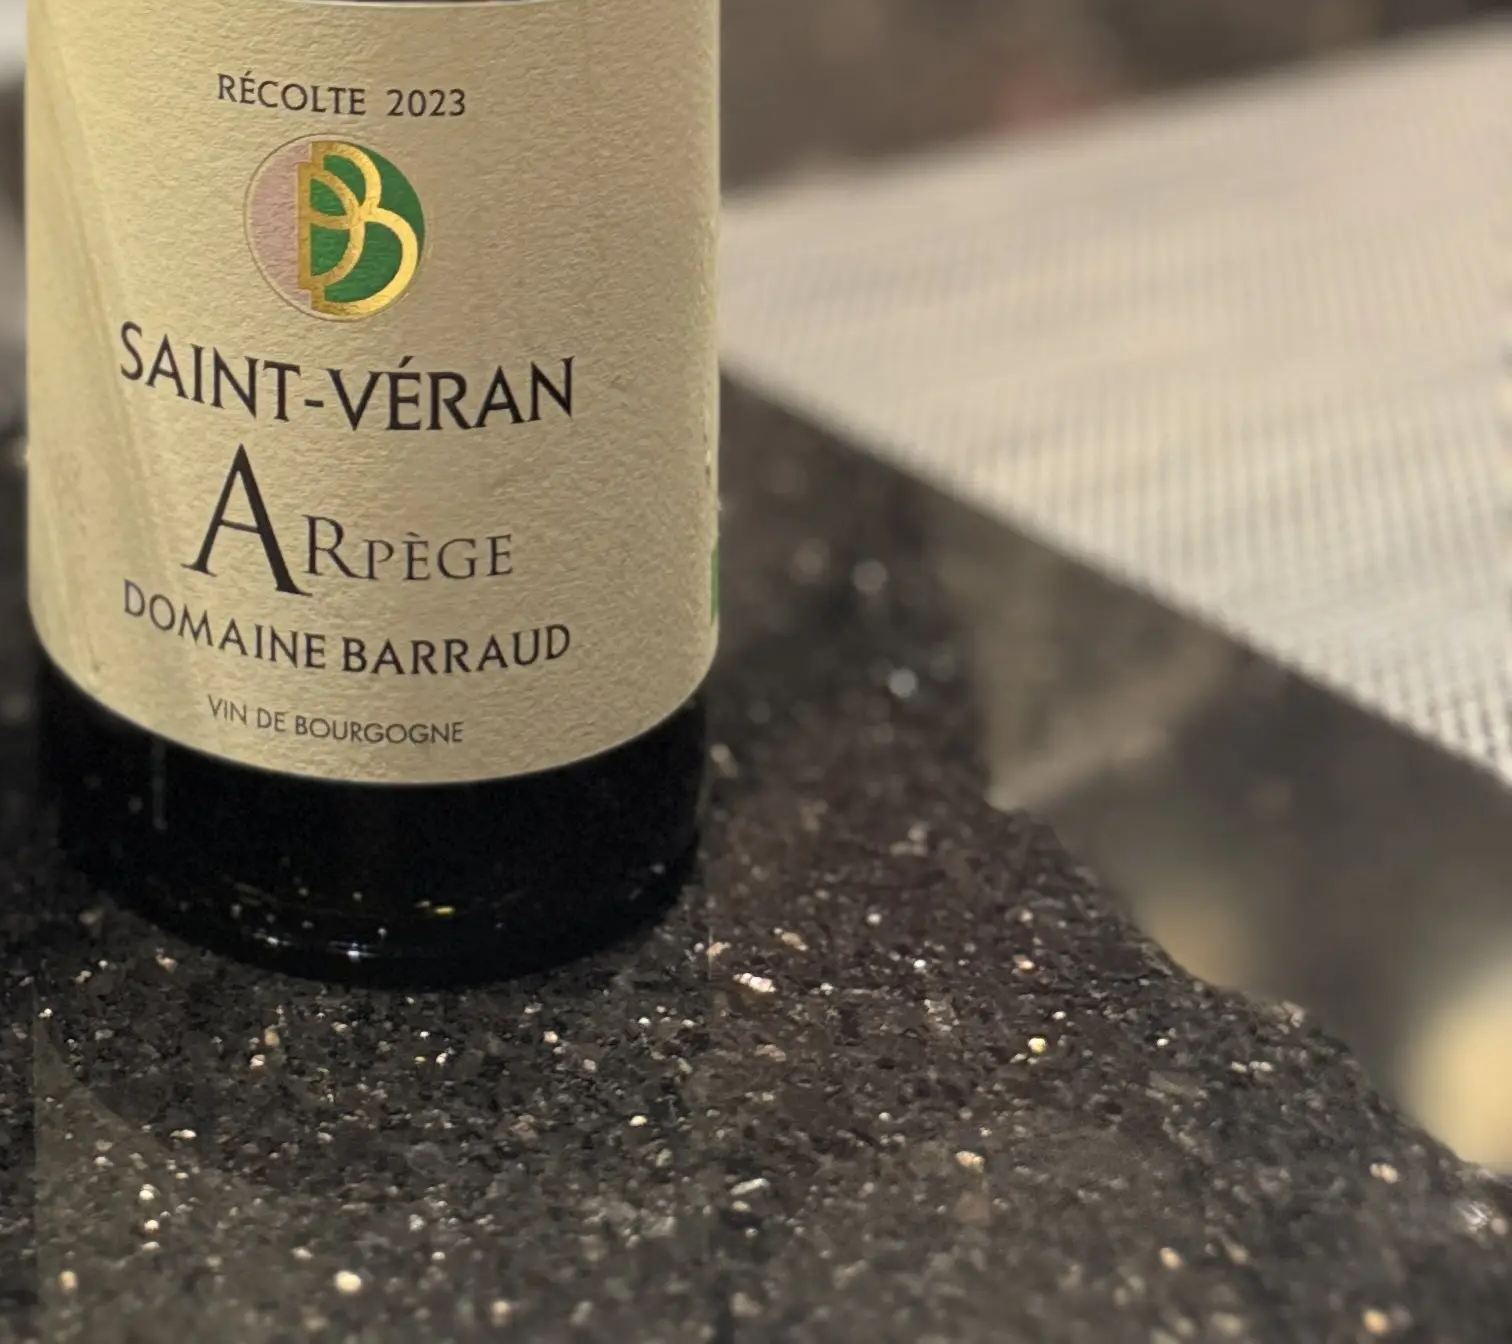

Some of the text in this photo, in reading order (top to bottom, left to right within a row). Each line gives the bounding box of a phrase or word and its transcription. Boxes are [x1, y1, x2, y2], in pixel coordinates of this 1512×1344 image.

[217, 72, 466, 117] RÉCOLTE 2023
[120, 321, 574, 432] SAINT-VÉRAN
[123, 580, 570, 674] DOMAINE BARRAUD
[208, 694, 464, 745] VIN DE BOURGOGNE
